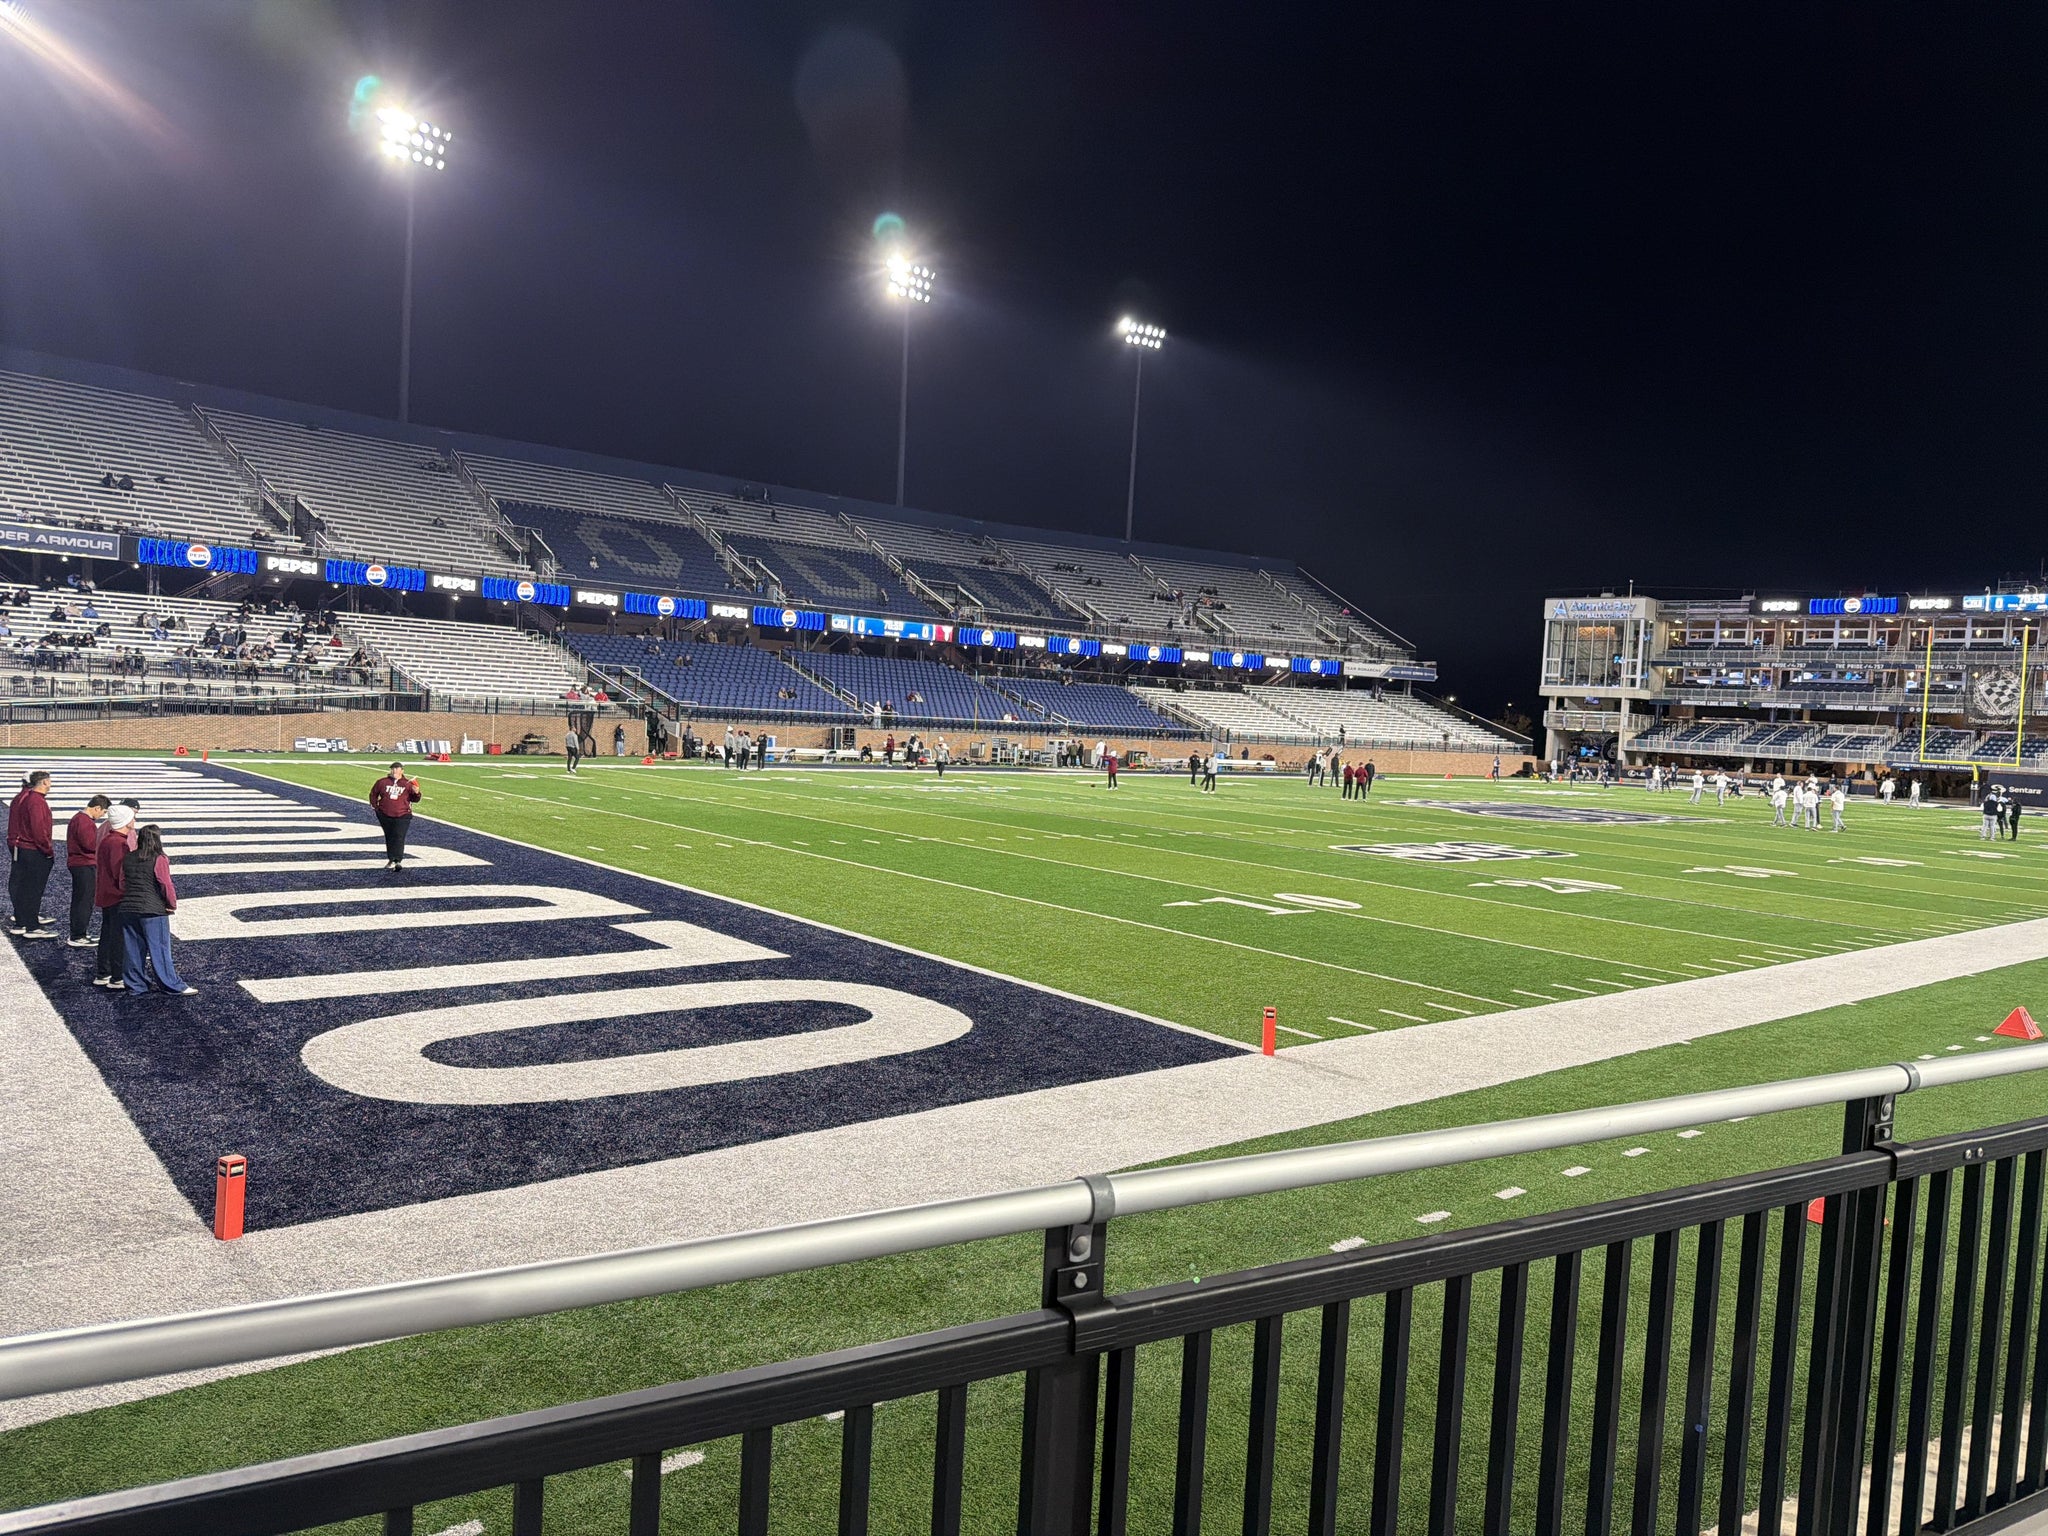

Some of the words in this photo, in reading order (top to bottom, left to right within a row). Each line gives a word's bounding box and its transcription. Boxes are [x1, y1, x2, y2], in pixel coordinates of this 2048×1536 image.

[35, 534, 113, 551] ARMOUR
[188, 550, 210, 560] PEPSI
[267, 556, 318, 574] PEPSI
[433, 575, 476, 592] PEPSI
[577, 591, 619, 607] PEPSI
[1909, 598, 1950, 610] PEPSI
[712, 605, 748, 619] PEPSI
[1571, 601, 1611, 612] Atlantic
[1613, 601, 1637, 614] Bay
[1762, 601, 1798, 612] PEPSI
[1968, 717, 2008, 725] Checkered
[179, 746, 185, 755] G
[2009, 786, 2043, 795] Sentara
[1494, 877, 1624, 894] 20
[1199, 893, 1363, 916] 10
[170, 884, 974, 1106] OLD
